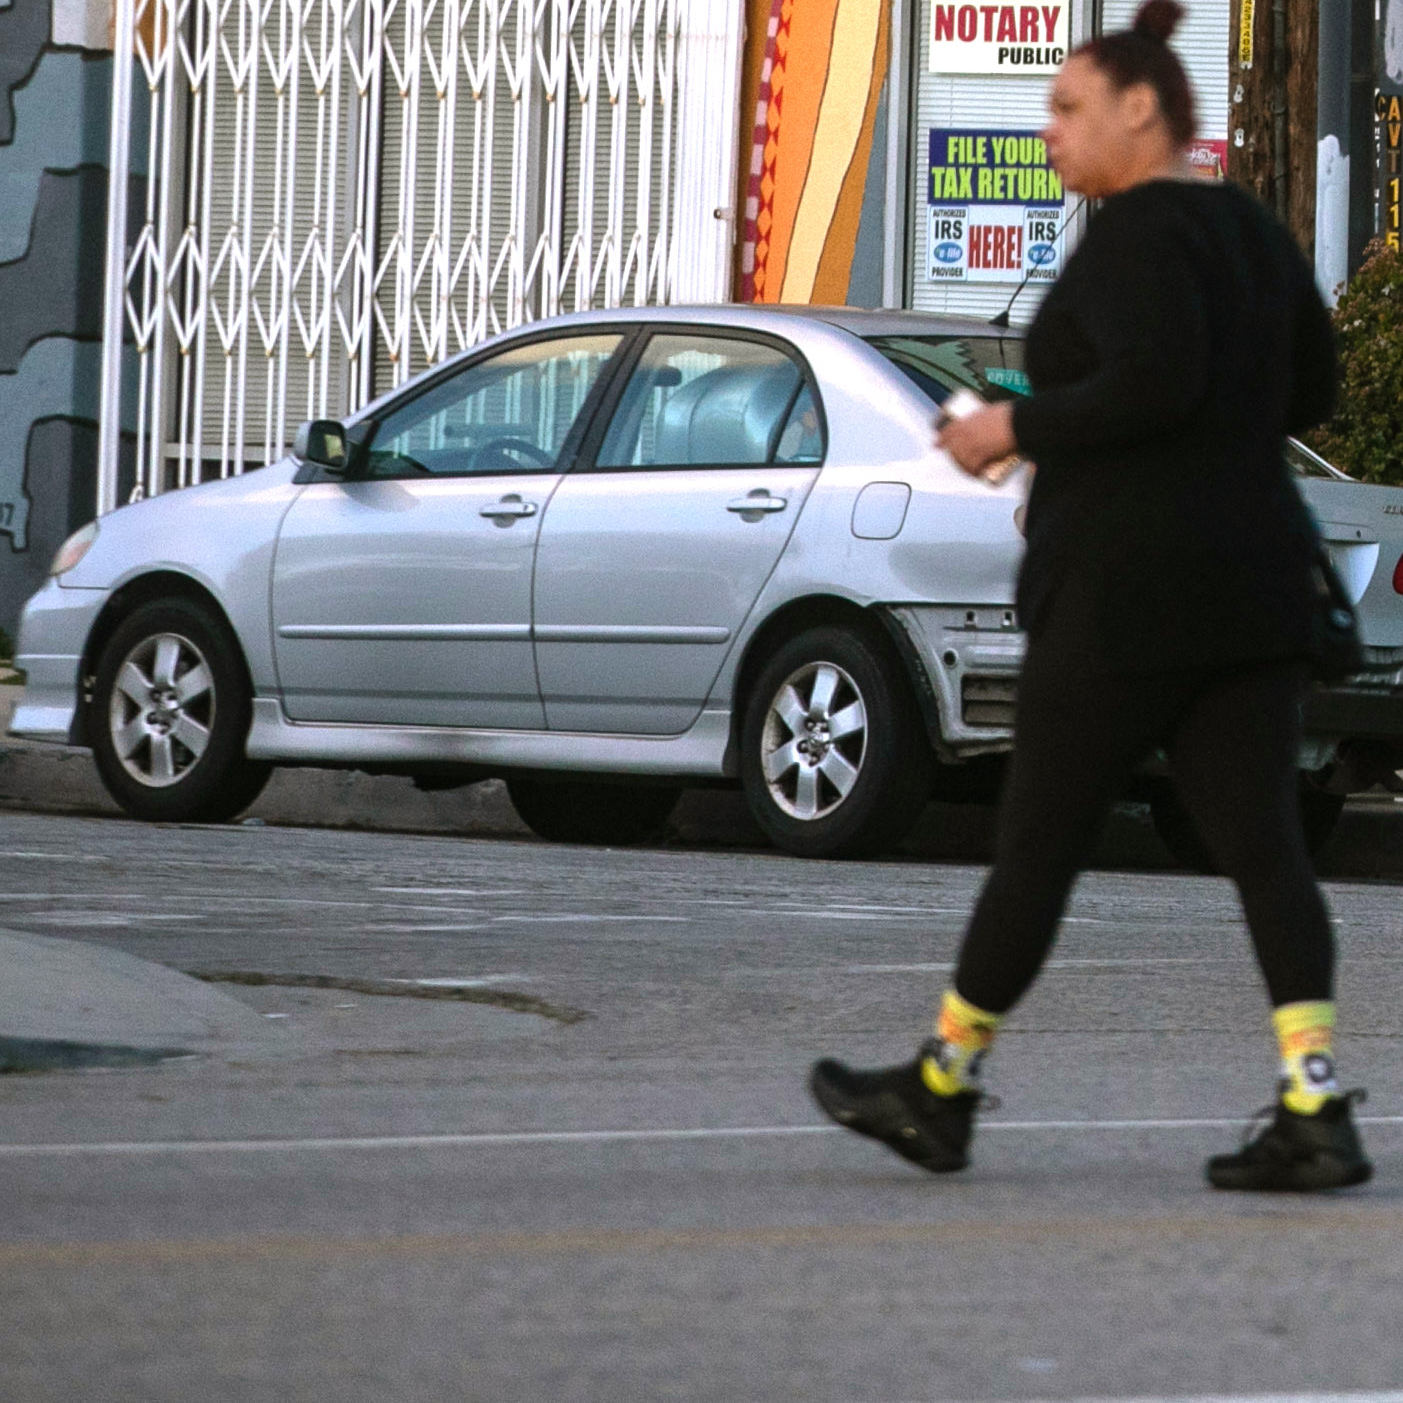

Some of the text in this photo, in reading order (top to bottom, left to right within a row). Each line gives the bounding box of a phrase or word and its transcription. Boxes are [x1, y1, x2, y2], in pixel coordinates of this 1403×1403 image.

[935, 4, 1062, 43] NOTARY
[998, 46, 1064, 66] PUBLIC
[947, 136, 1048, 166] FILE YOUR
[931, 167, 1063, 201] TAX RETURN
[932, 208, 967, 219] AUTHORIZED
[1027, 209, 1060, 220] AUTHORIZED
[934, 219, 963, 240] IRS
[1028, 221, 1057, 241] IRS
[968, 224, 1023, 270] HERE!
[932, 267, 963, 278] PROVIDER
